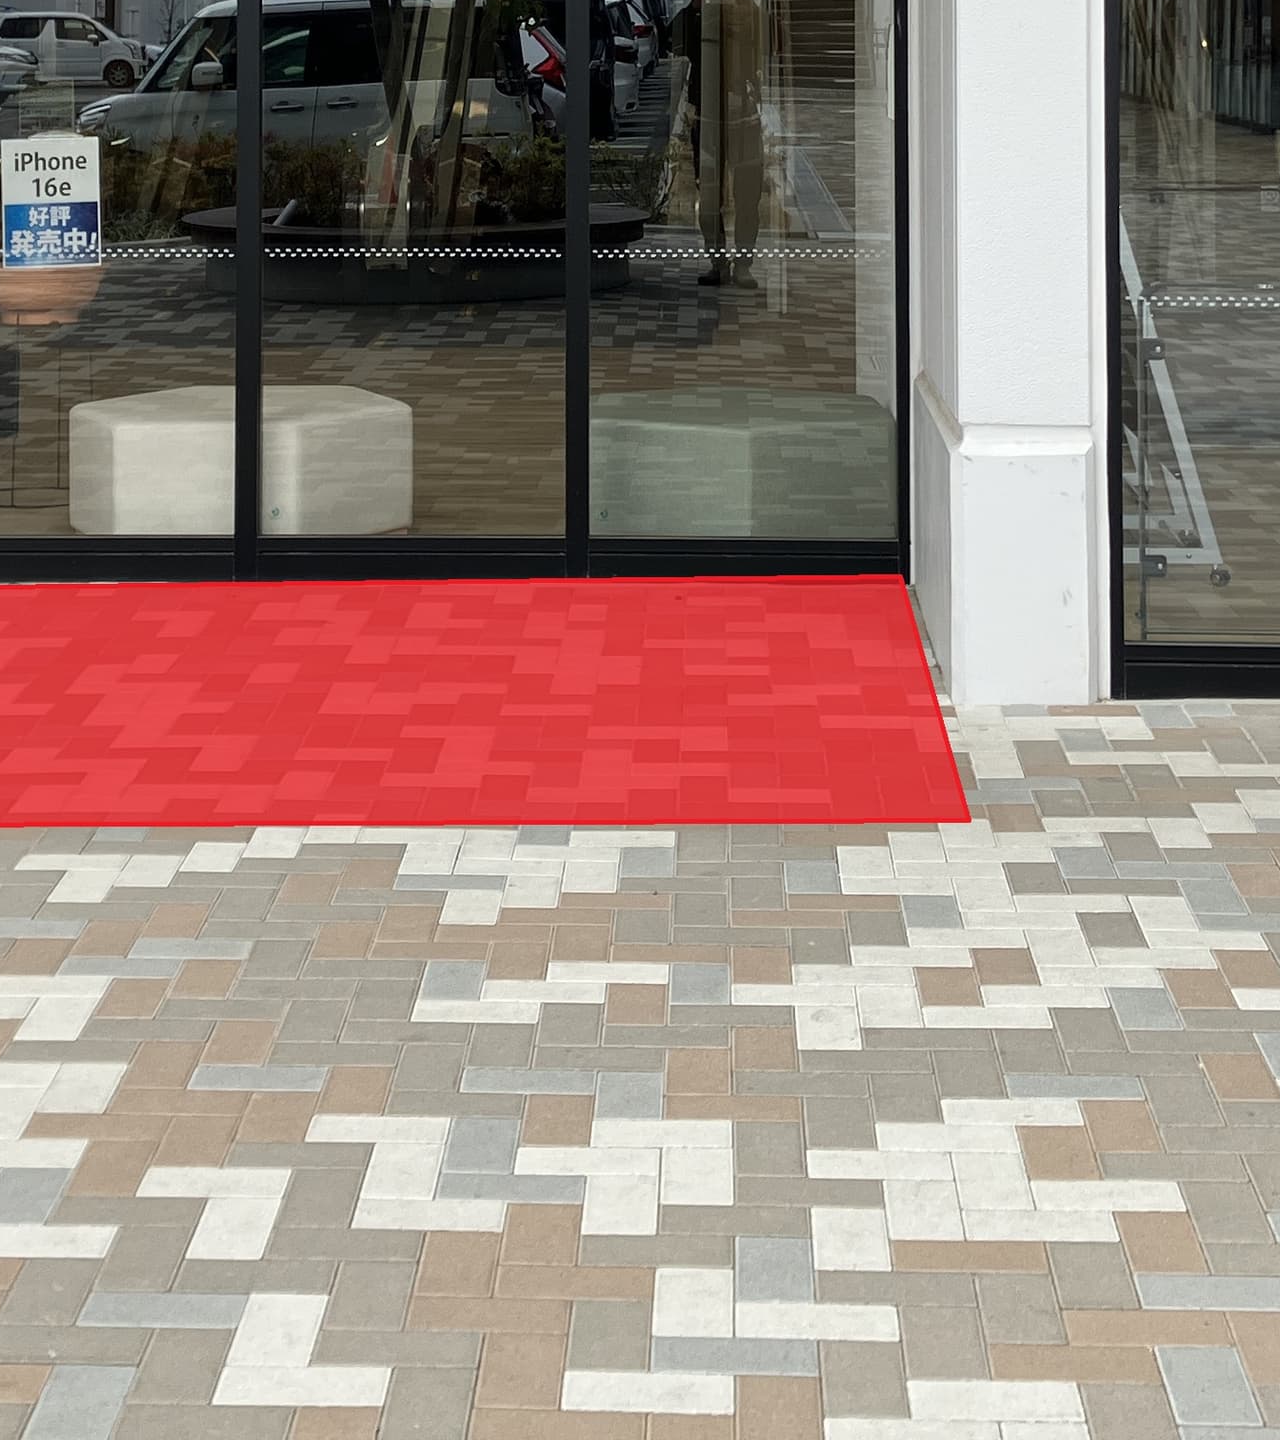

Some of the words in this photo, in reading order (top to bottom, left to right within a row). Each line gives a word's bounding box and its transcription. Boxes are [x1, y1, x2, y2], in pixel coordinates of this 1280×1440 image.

[14, 152, 87, 172] iPhone
[32, 177, 72, 198] 16e
[28, 206, 71, 227] 好評
[10, 227, 97, 257] 発売中!
